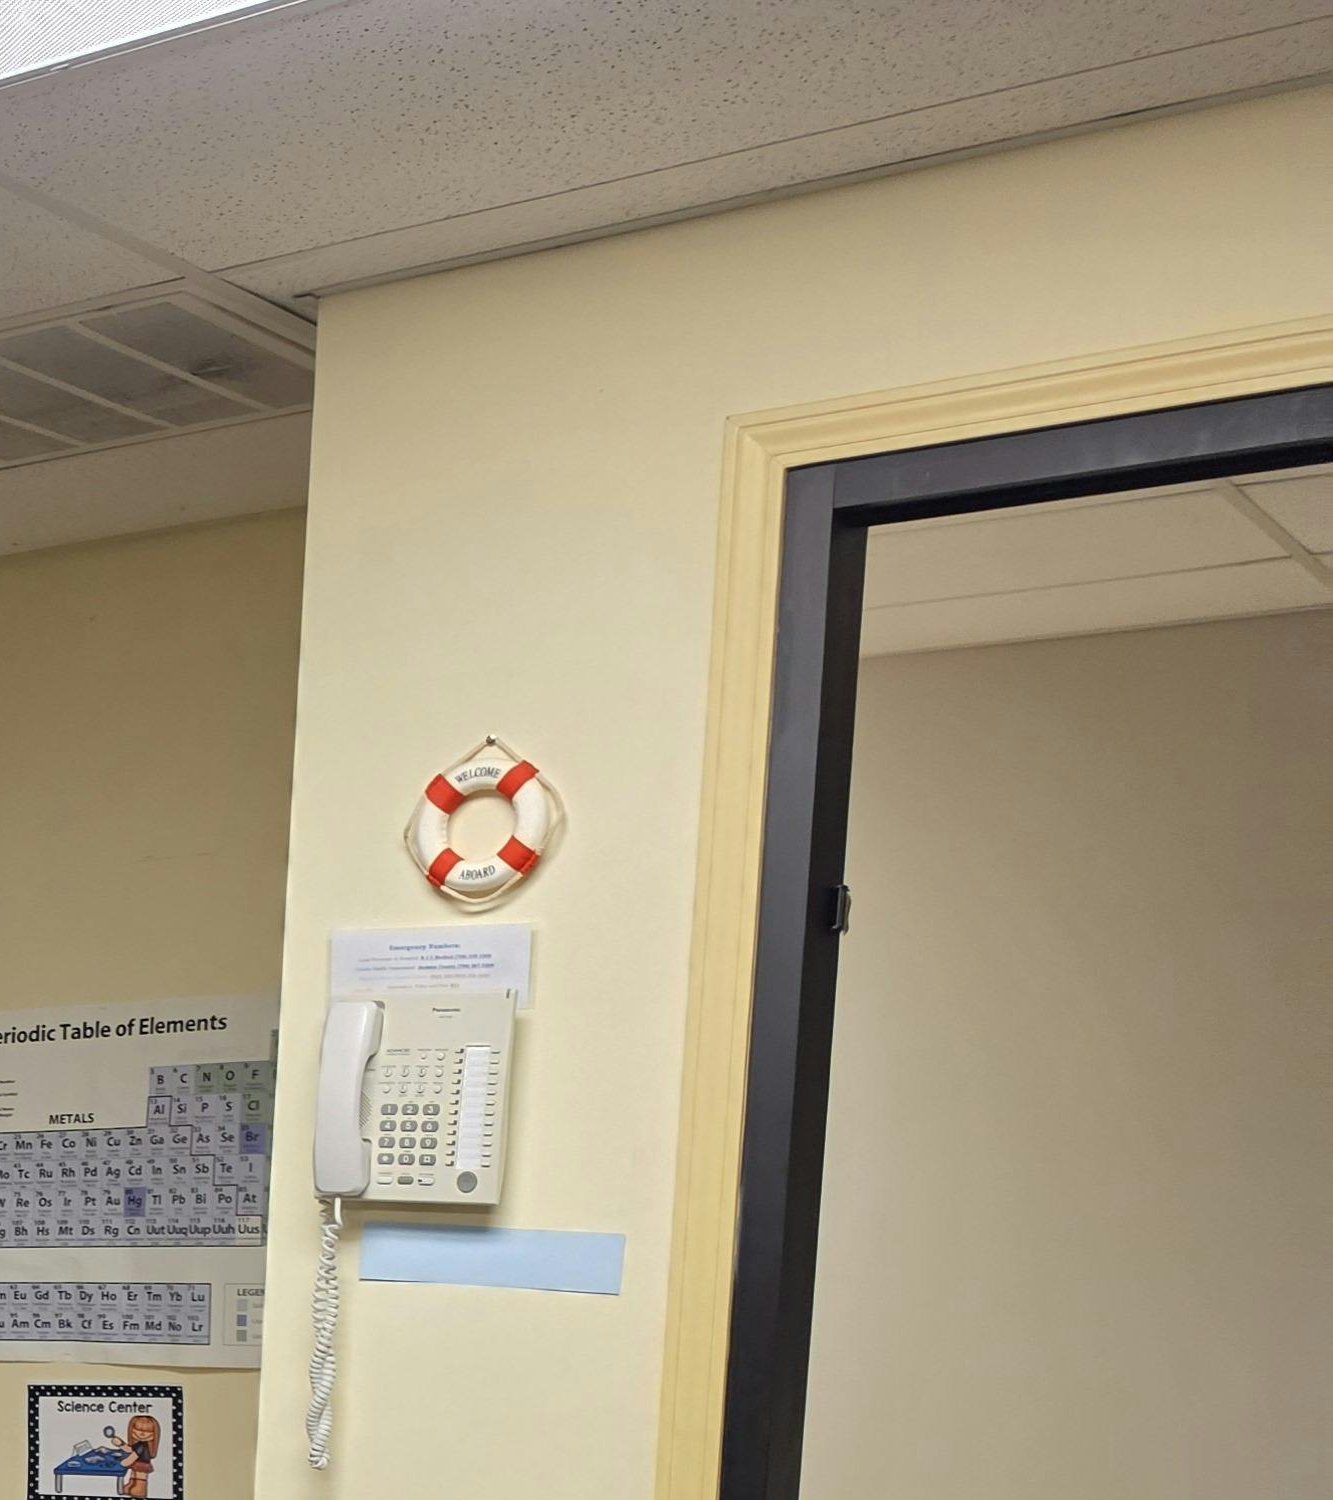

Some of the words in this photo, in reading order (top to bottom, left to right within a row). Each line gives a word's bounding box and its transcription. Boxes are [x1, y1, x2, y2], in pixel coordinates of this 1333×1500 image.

[455, 767, 501, 783] WELCOME
[459, 865, 496, 880] ABOARD
[60, 1022, 111, 1040] Table
[115, 1019, 135, 1037] of
[138, 1014, 227, 1035] Elements
[153, 1105, 165, 1114] Al
[177, 1104, 187, 1113] Si
[49, 1113, 95, 1125] METALS
[16, 1141, 32, 1149] Mn
[41, 1140, 53, 1148] Fe
[86, 1137, 97, 1146] Ni
[107, 1137, 120, 1146] Cu
[106, 1167, 120, 1178] Ag
[195, 1164, 209, 1173] Sb
[128, 1197, 142, 1207] Hg
[37, 1227, 49, 1236] Hs
[238, 1222, 260, 1233] Uus
[147, 1293, 161, 1301] Tm
[145, 1321, 161, 1330] Md
[57, 1400, 104, 1412] Science
[109, 1401, 153, 1413] Center
